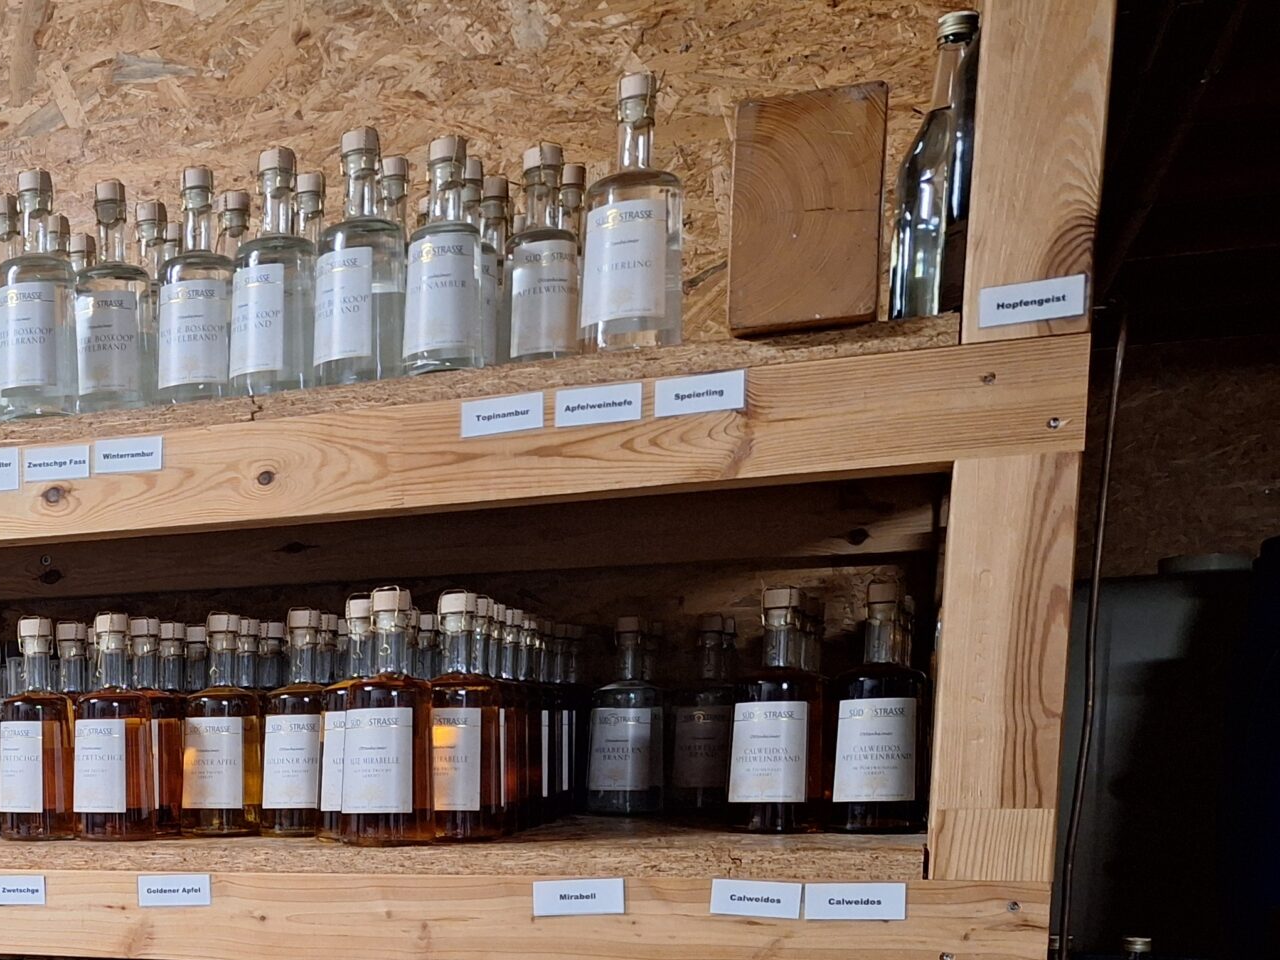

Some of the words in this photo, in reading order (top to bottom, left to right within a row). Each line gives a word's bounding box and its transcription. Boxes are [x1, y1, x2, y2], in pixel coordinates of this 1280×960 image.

[996, 293, 1066, 312] Hopfengeist
[674, 387, 726, 401] Speierling
[564, 398, 634, 414] Apfelweinhefe
[476, 407, 530, 423] Topinambur
[103, 450, 155, 461] Winterrambur
[27, 459, 67, 469] Zwetschge
[69, 458, 86, 466] Fass
[763, 710, 794, 719] STRASSE
[874, 706, 906, 717] STRASSE
[369, 717, 400, 726] STRASSE
[2, 886, 40, 896] Zwetschge
[146, 887, 179, 895] Goldener
[181, 886, 201, 896] Apfel
[559, 891, 596, 901] Mirabell
[729, 893, 782, 905] Calweidos
[827, 896, 882, 907] Calweidos
